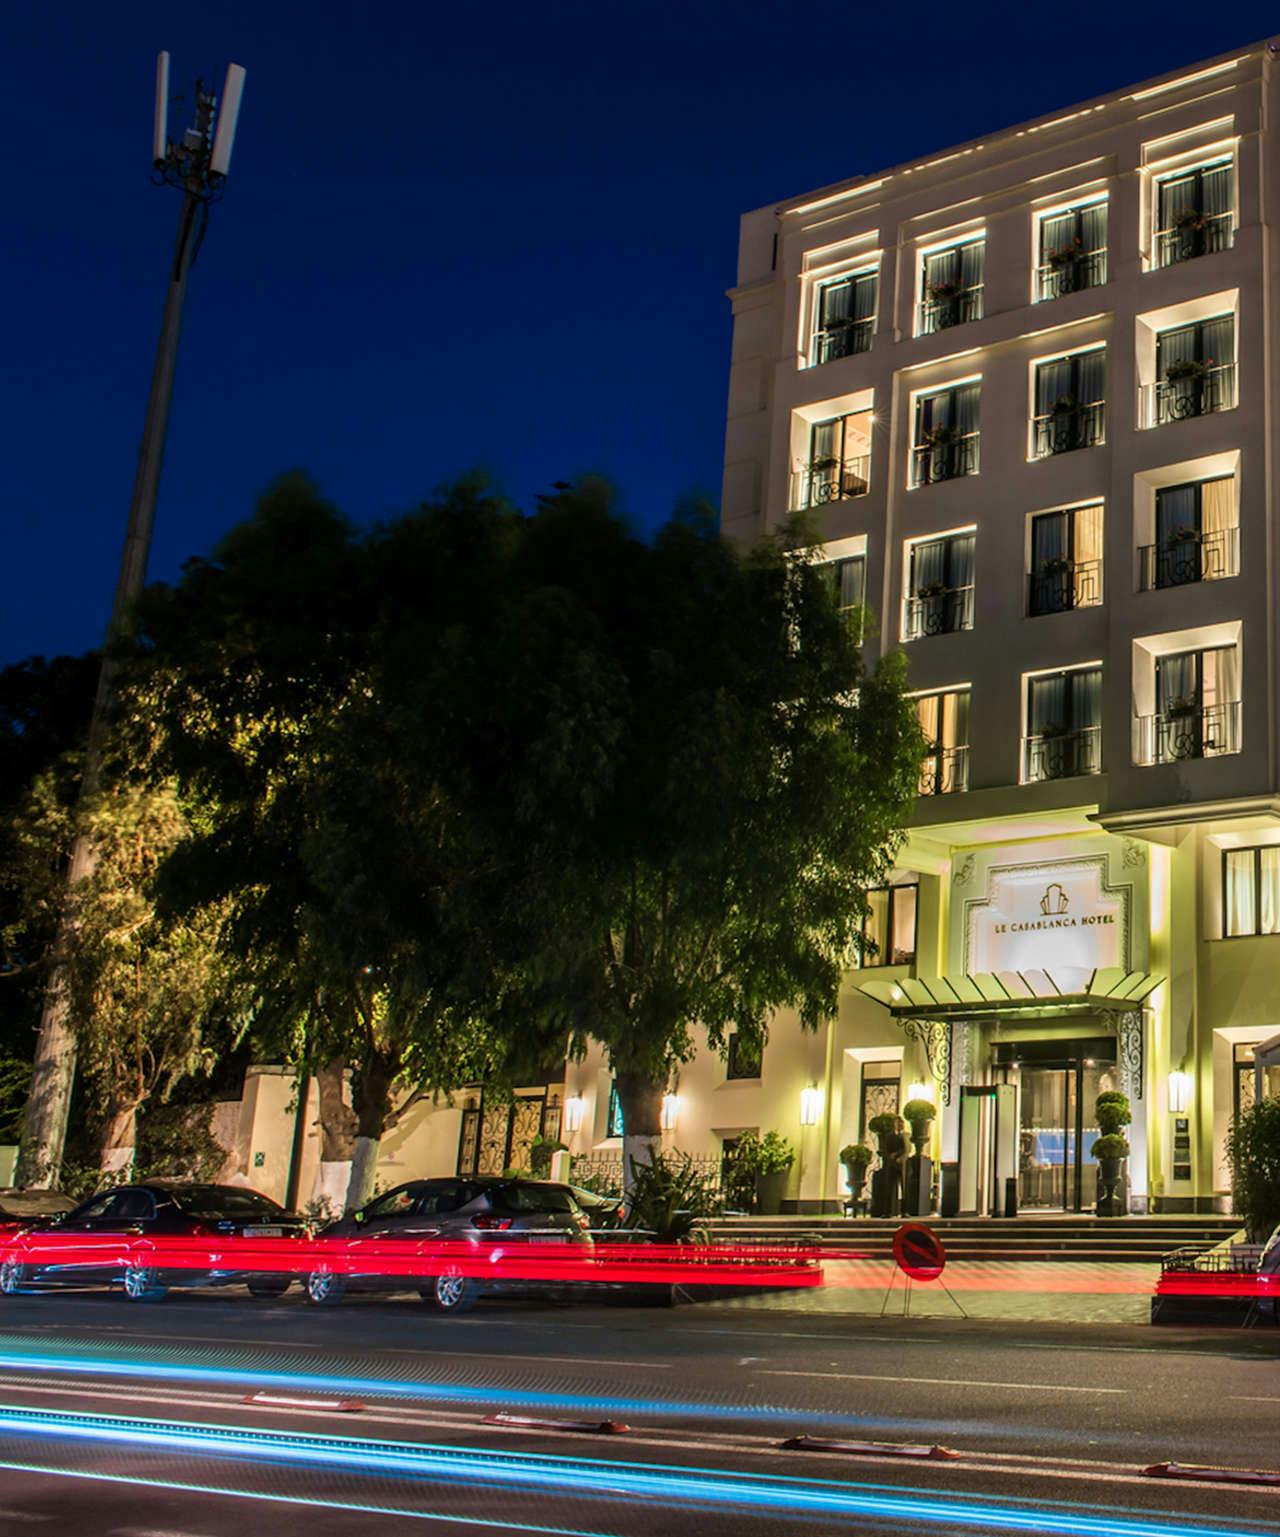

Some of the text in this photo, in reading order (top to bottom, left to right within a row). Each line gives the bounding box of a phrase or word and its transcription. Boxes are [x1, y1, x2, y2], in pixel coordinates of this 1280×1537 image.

[995, 914, 1115, 934] LE CASABLANCA HOTEL
